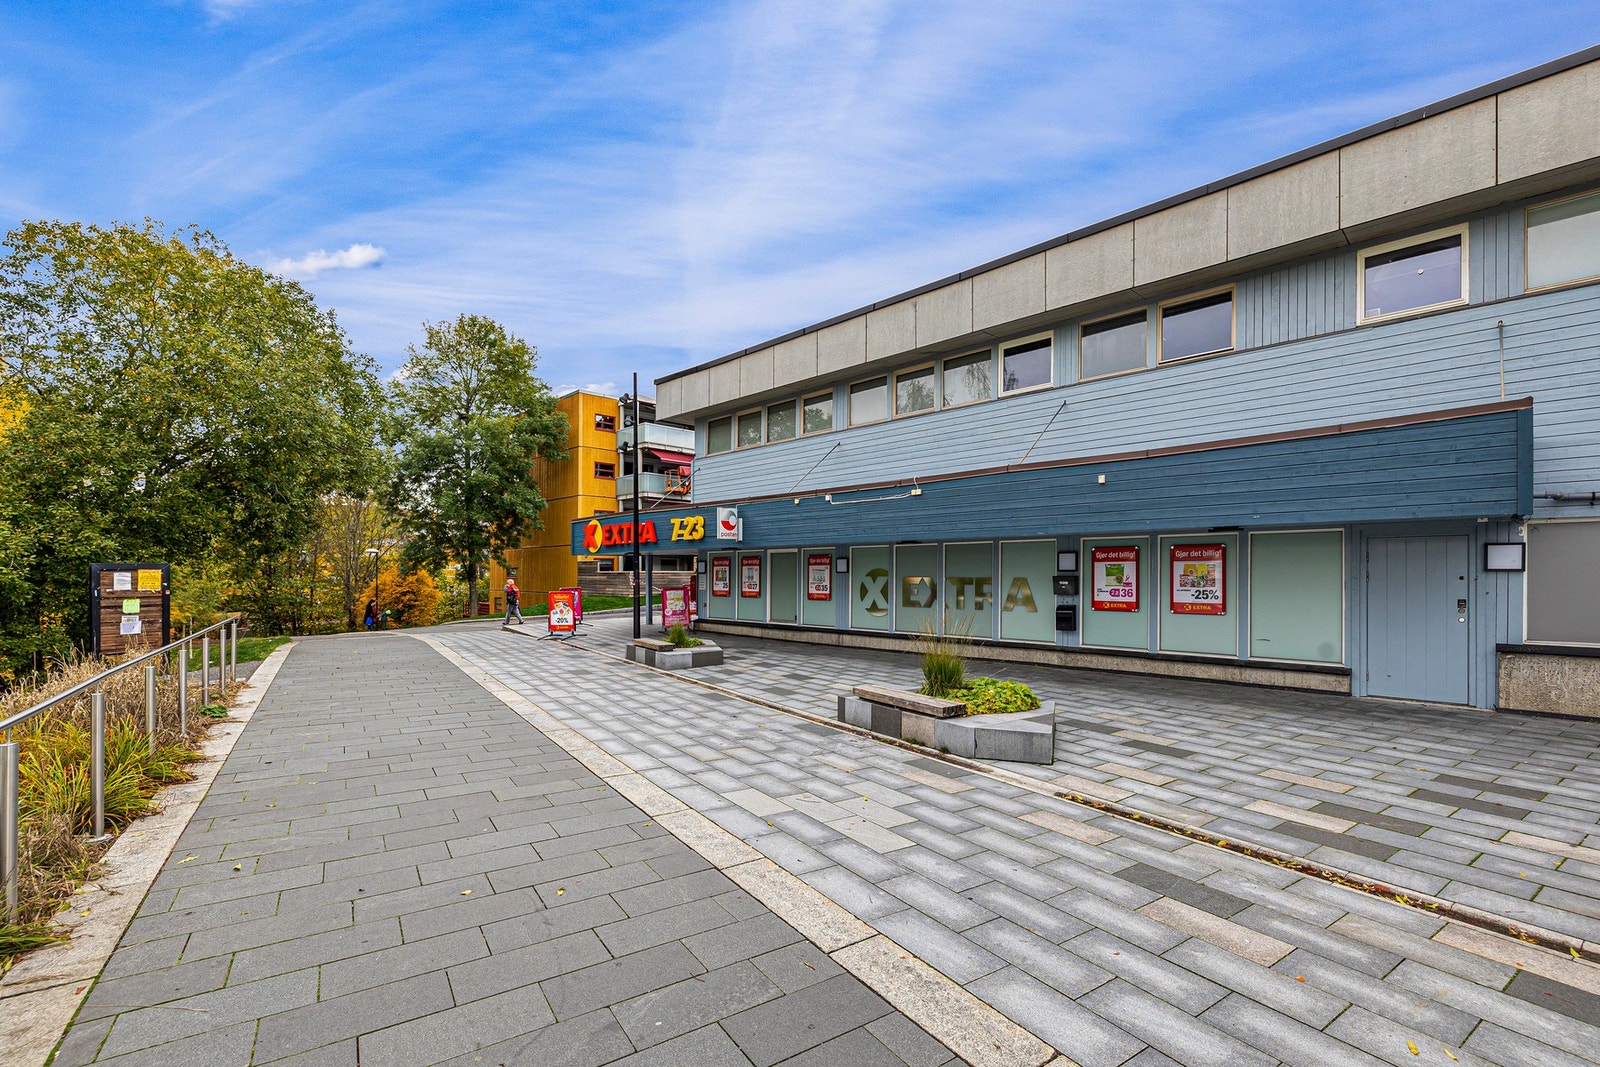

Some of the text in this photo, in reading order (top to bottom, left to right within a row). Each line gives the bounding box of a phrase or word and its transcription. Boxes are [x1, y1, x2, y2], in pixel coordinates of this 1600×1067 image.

[670, 515, 705, 541] 7-23
[1095, 552, 1108, 560] Gjør
[1120, 588, 1134, 598] 36
[1191, 589, 1220, 600] -25%
